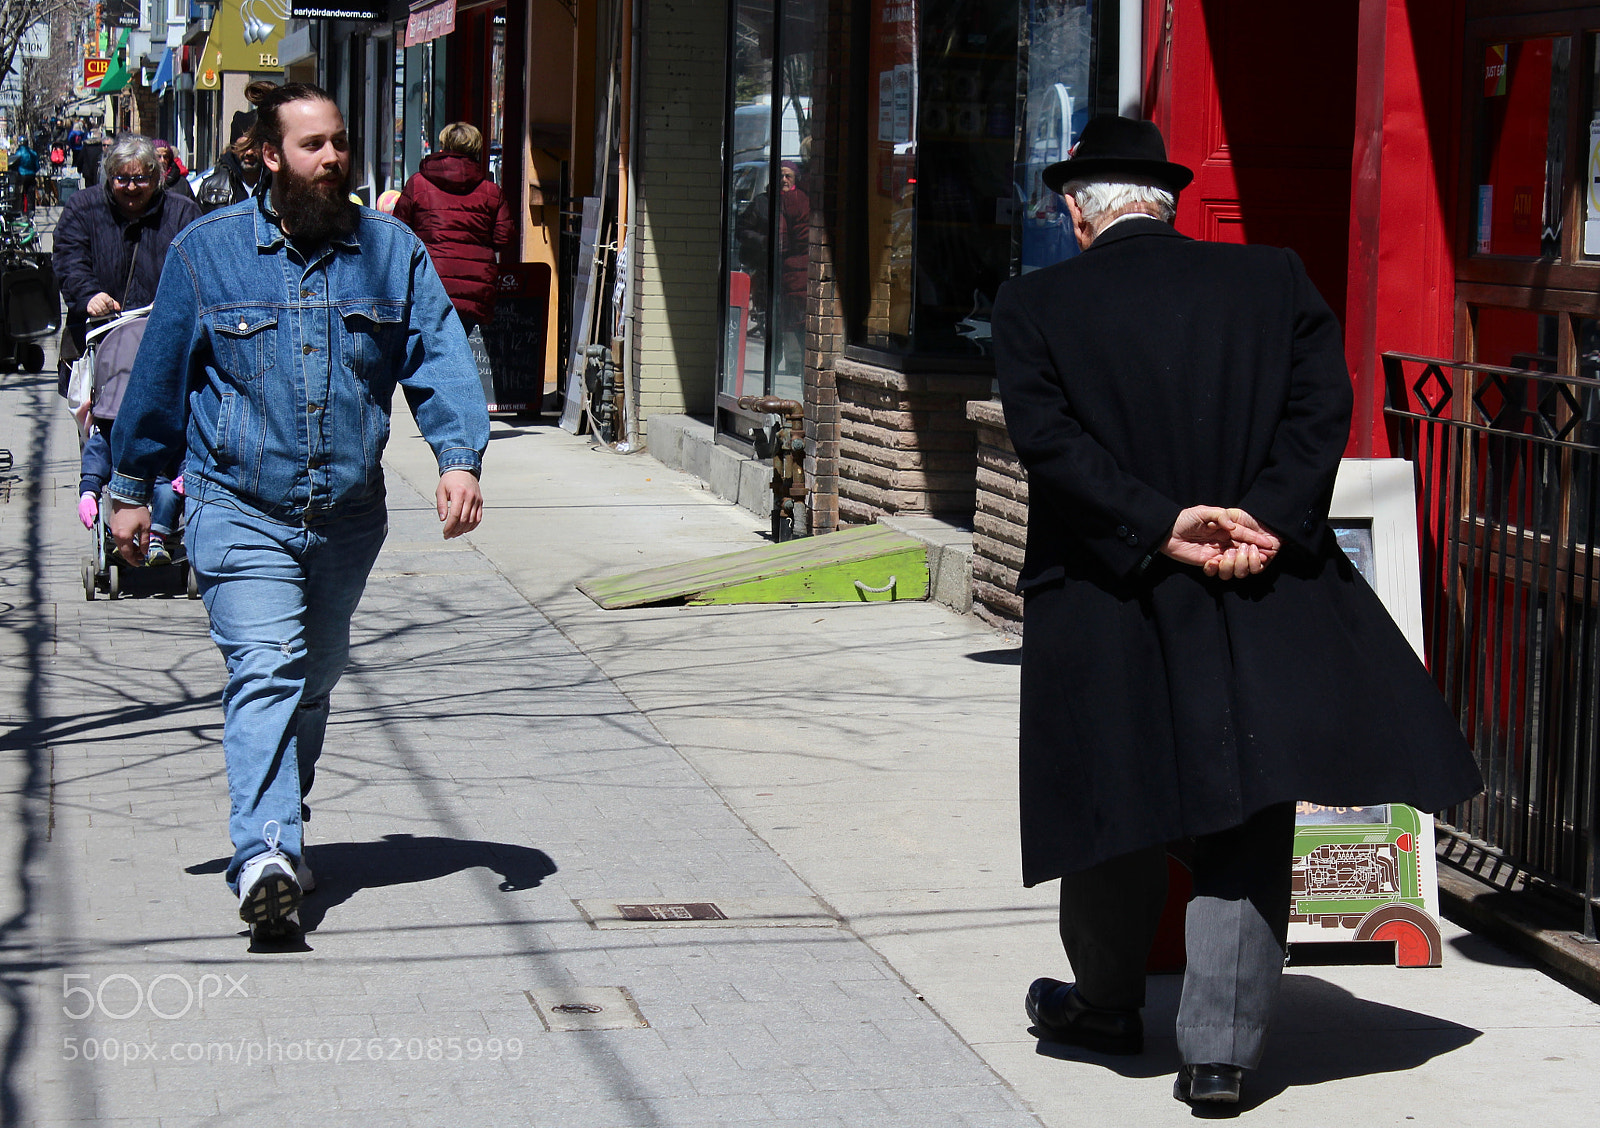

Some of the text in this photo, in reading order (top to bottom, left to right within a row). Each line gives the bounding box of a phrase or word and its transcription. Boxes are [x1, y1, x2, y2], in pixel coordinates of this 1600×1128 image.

[293, 7, 379, 18] earlybirdandworm.com
[259, 53, 279, 66] Ho
[87, 60, 109, 73] CIB
[1485, 63, 1506, 79] JUST EAT
[1513, 193, 1532, 215] ATM
